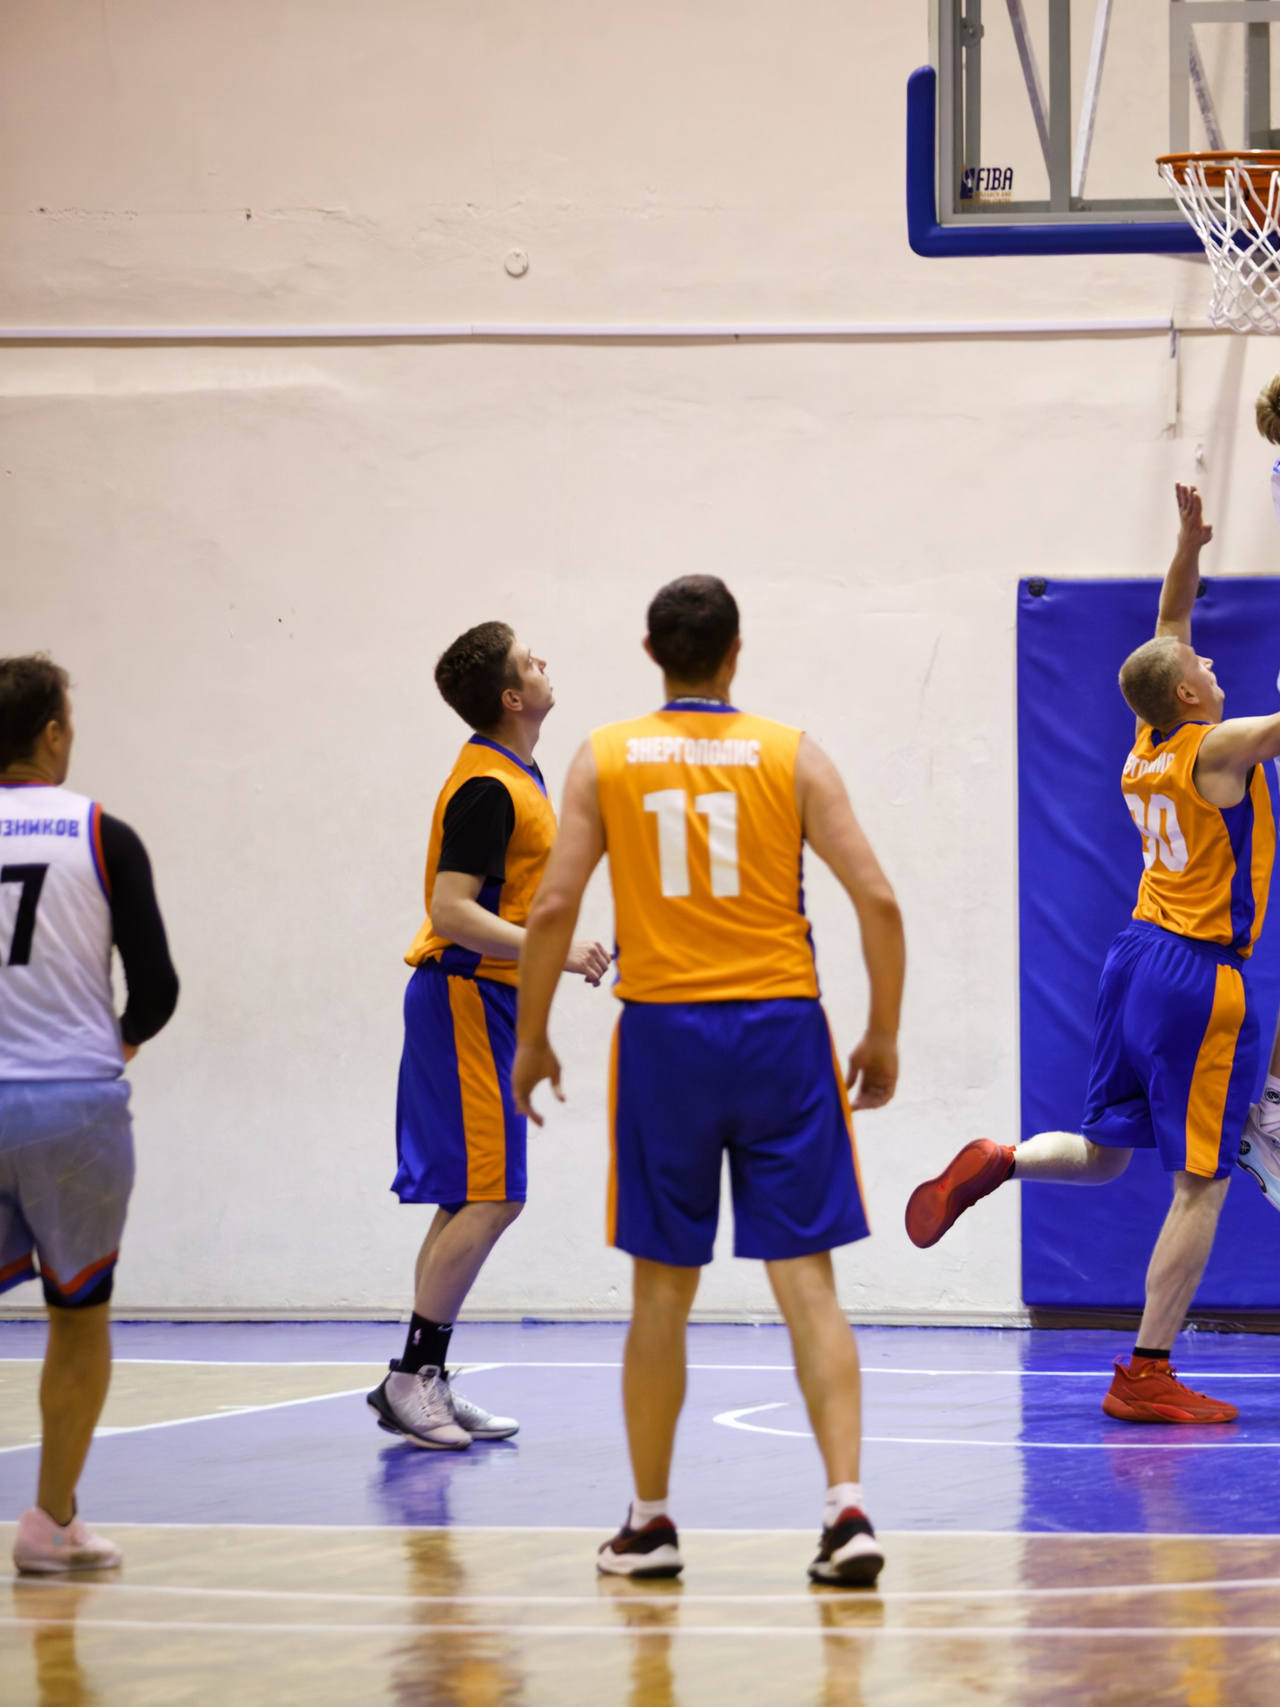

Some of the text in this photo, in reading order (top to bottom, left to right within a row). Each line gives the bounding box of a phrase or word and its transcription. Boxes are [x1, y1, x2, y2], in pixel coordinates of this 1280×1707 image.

[976, 167, 1013, 191] FIBA
[0, 819, 79, 838] ЗНИКОВ
[643, 788, 741, 898] 11
[0, 863, 50, 967] 7
